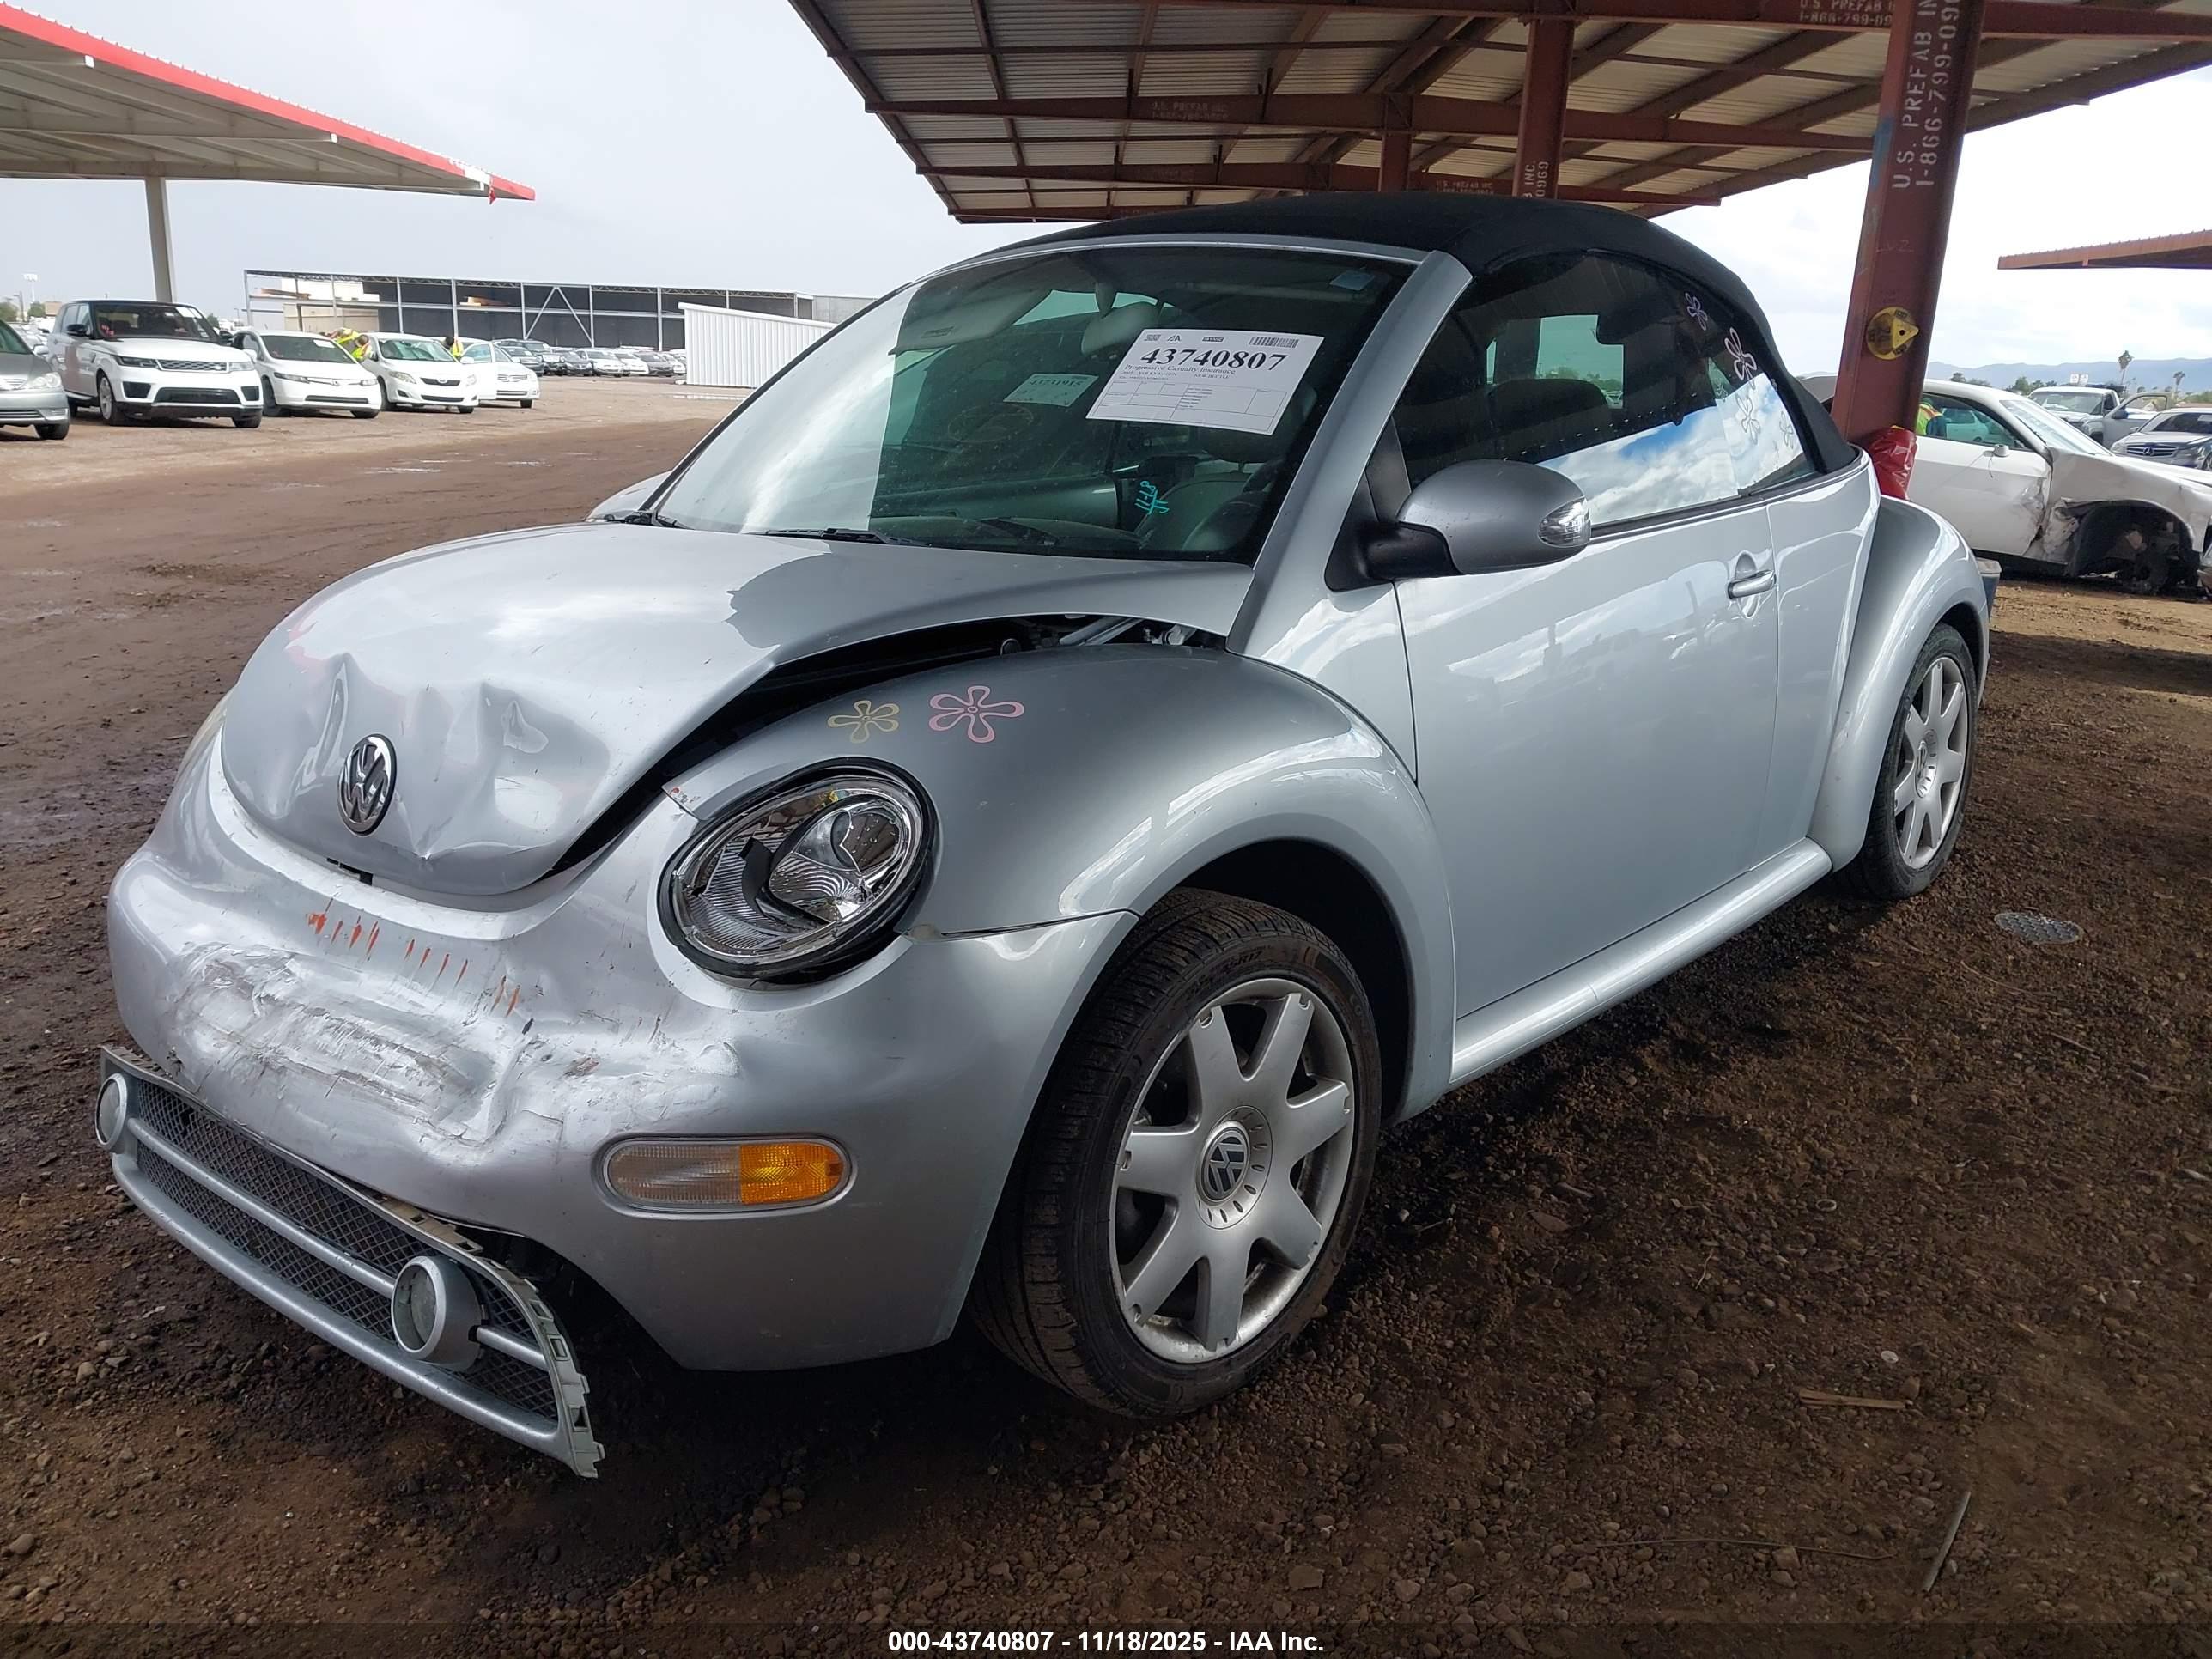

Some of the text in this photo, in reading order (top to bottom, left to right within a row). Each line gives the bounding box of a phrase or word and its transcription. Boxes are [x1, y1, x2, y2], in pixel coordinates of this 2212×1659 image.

[1903, 32, 1932, 128] PREFAB
[1916, 0, 1960, 187] 1-866-799-09
[1124, 363, 1167, 372] Progressive
[1167, 365, 1199, 374] Casualty
[1140, 348, 1288, 372] 43740807
